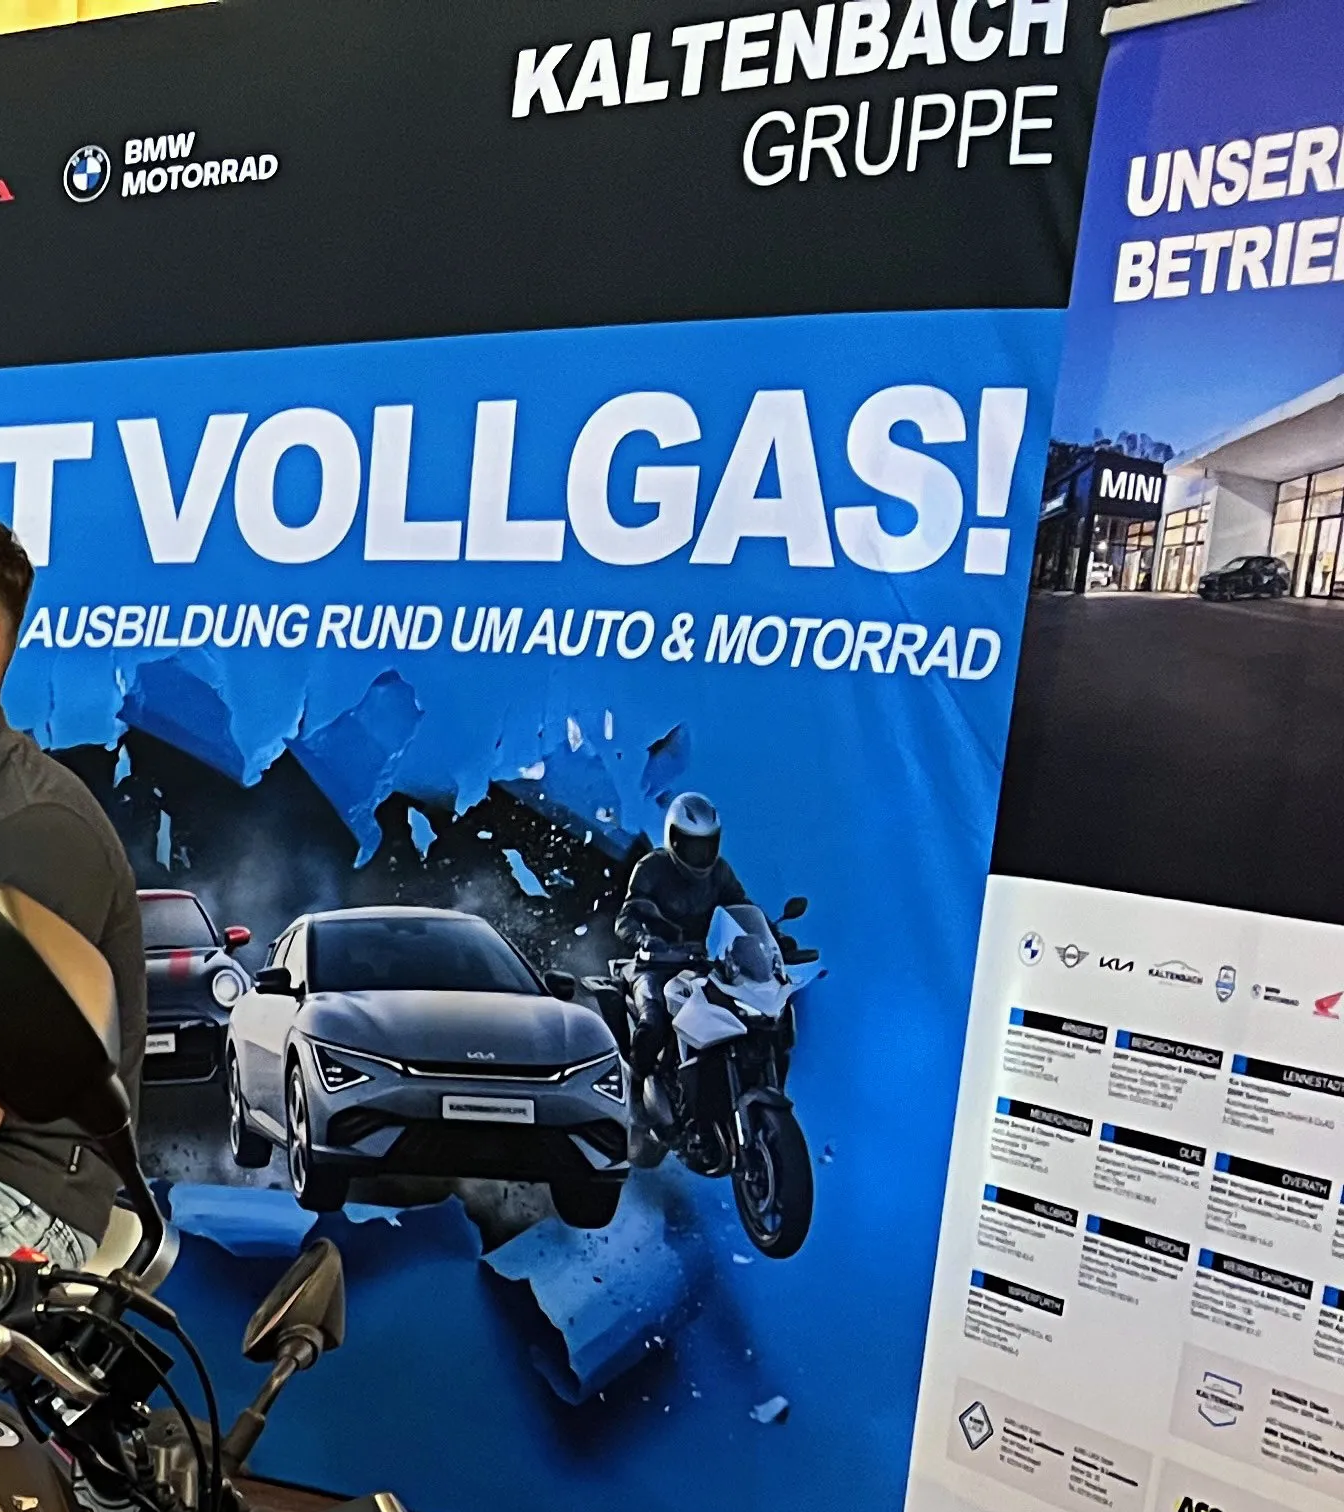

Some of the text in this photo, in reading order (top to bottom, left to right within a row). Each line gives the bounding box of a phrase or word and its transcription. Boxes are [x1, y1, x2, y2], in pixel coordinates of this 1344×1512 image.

[512, 0, 1068, 118] KALTENBACH
[121, 154, 279, 197] MOTORRAD
[124, 131, 196, 165] BMW
[742, 85, 1059, 187] GRUPPE
[1127, 126, 1344, 217] UNSER
[1113, 216, 1344, 303] BETRIE
[117, 384, 1029, 576] VOLLGAS!
[1099, 468, 1162, 504] MINI
[20, 603, 1001, 682] AUSBILDUNG RUND UM AUTO & MOTORRAD
